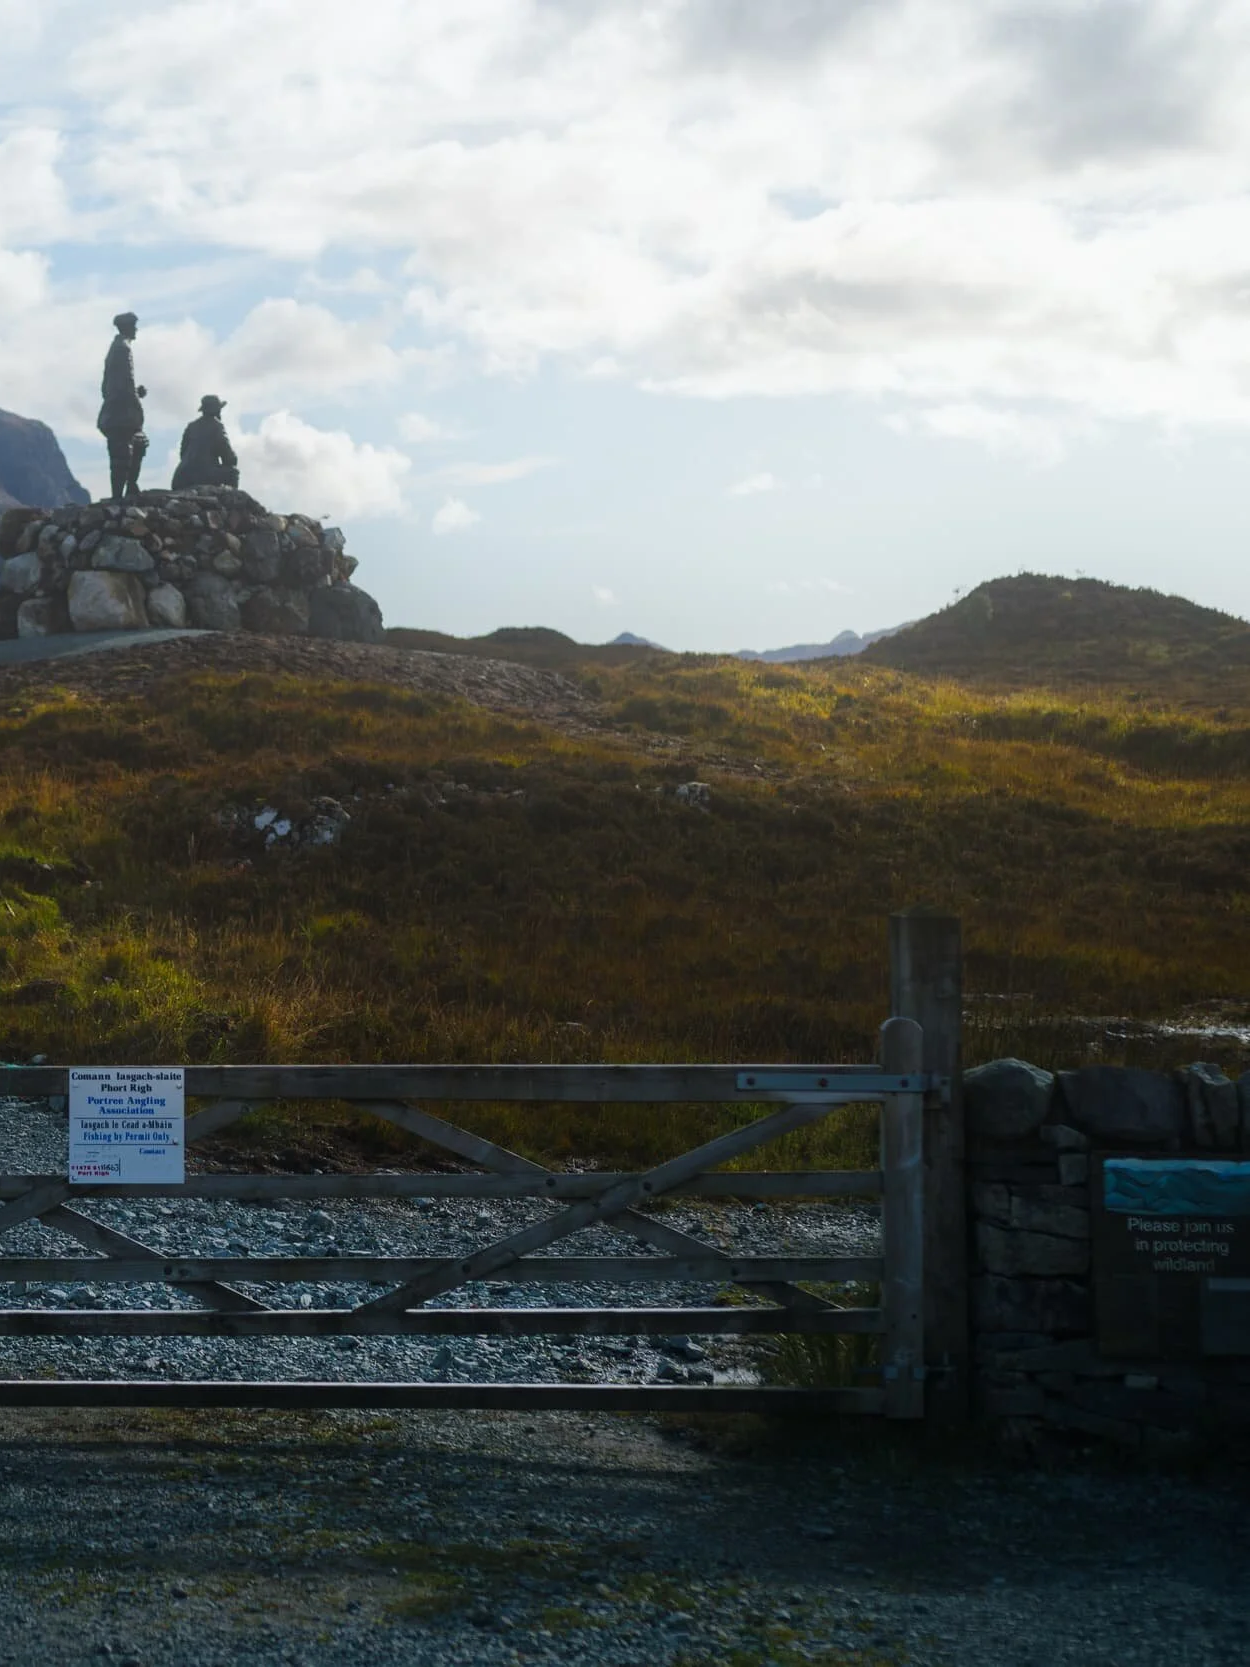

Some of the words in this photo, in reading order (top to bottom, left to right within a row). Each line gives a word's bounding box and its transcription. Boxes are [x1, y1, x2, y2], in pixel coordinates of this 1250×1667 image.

[71, 1072, 111, 1081] Comann
[116, 1072, 182, 1082] Iasgach-slaite
[100, 1083, 127, 1092] Phort
[130, 1083, 152, 1094] Righ
[87, 1096, 124, 1105] Portree
[127, 1096, 166, 1107] Angling
[99, 1106, 155, 1115] Association
[80, 1120, 109, 1131] Iasgach
[112, 1120, 119, 1129] le
[121, 1120, 139, 1129] Cead
[83, 1132, 112, 1142] Fishing
[113, 1132, 122, 1142] by
[125, 1132, 150, 1141] Permit
[152, 1132, 170, 1142] Only
[1126, 1217, 1181, 1233] Please
[1183, 1219, 1212, 1238] join
[1216, 1223, 1237, 1233] us
[1134, 1237, 1150, 1251] in
[1153, 1239, 1231, 1257] protecting
[1153, 1257, 1216, 1273] wildland
